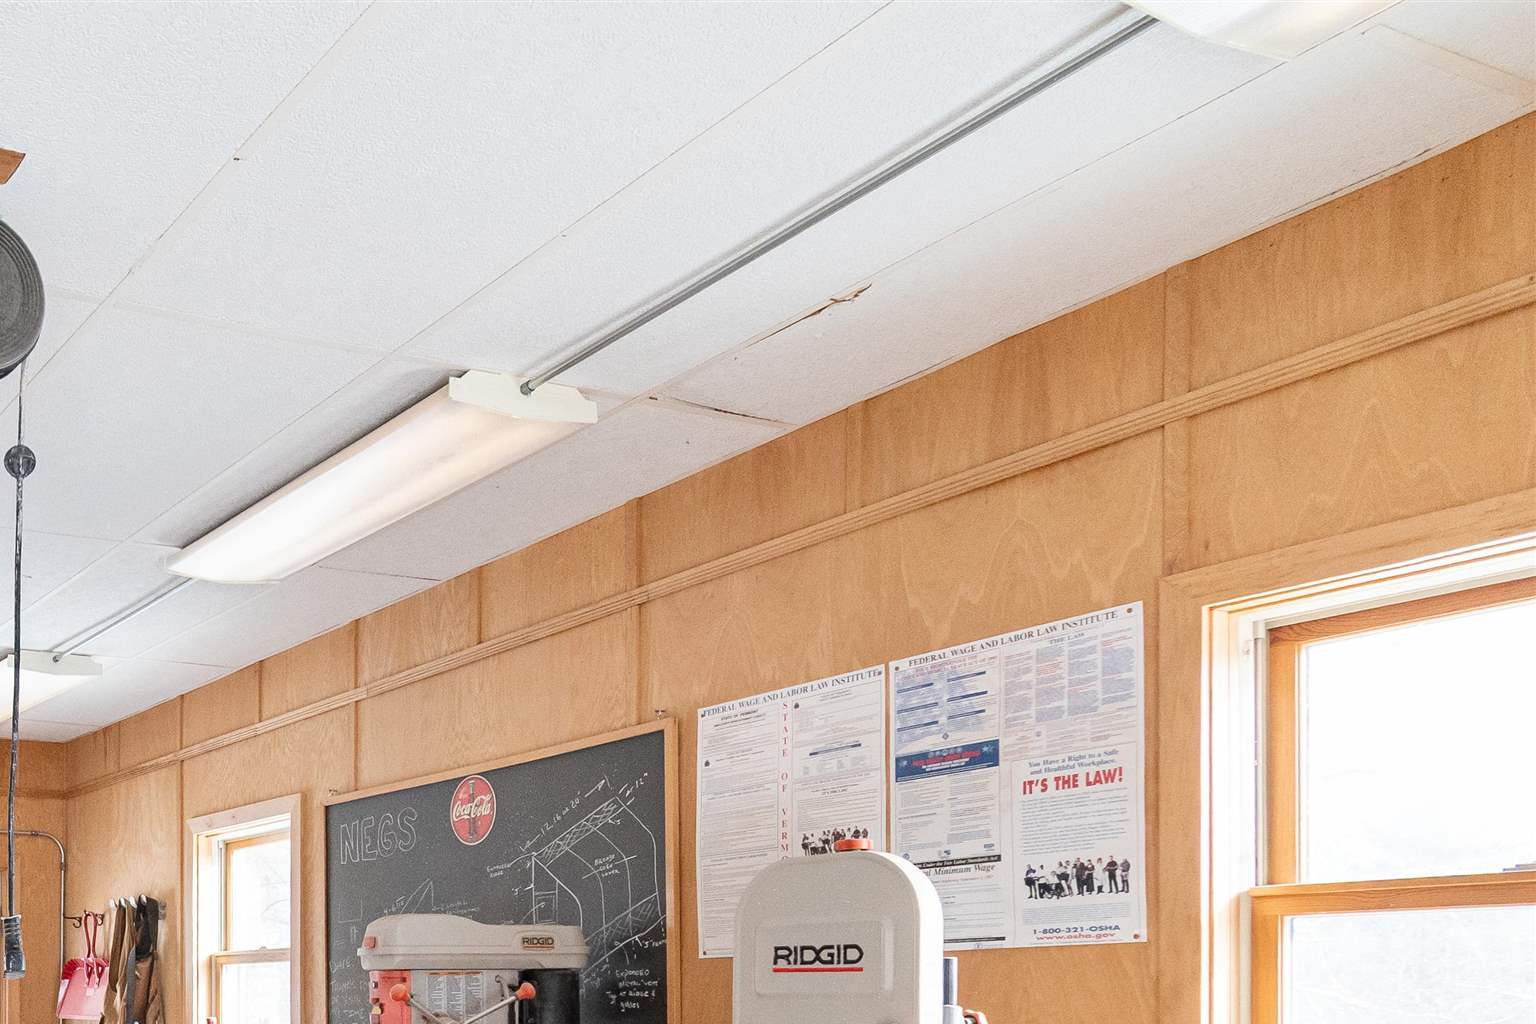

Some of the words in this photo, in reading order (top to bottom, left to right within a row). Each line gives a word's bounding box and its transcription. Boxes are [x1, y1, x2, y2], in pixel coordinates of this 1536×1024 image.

[908, 652, 948, 667] FEDERAL
[950, 644, 977, 656] WAGE
[980, 639, 999, 651] AND
[1001, 630, 1035, 646] LABOR
[1036, 624, 1058, 636] LAW
[1060, 610, 1119, 630] INSTITUTE
[703, 704, 736, 718] FEDERAL
[738, 698, 760, 708] WAGE
[763, 693, 779, 703] AND
[780, 686, 809, 699] LABOR
[810, 681, 830, 693] LAW
[831, 669, 879, 686] INSTITUTE
[1022, 777, 1049, 795] IT'S
[1054, 773, 1079, 791] THE
[1085, 766, 1123, 787] LAW!
[340, 806, 418, 865] NEGS
[974, 864, 996, 873] Wage
[522, 936, 555, 946] RIDGID
[1033, 924, 1121, 935] 1-800-321-OSHA
[1036, 932, 1117, 941] www.osha.gov
[772, 943, 864, 966] RIDGID
